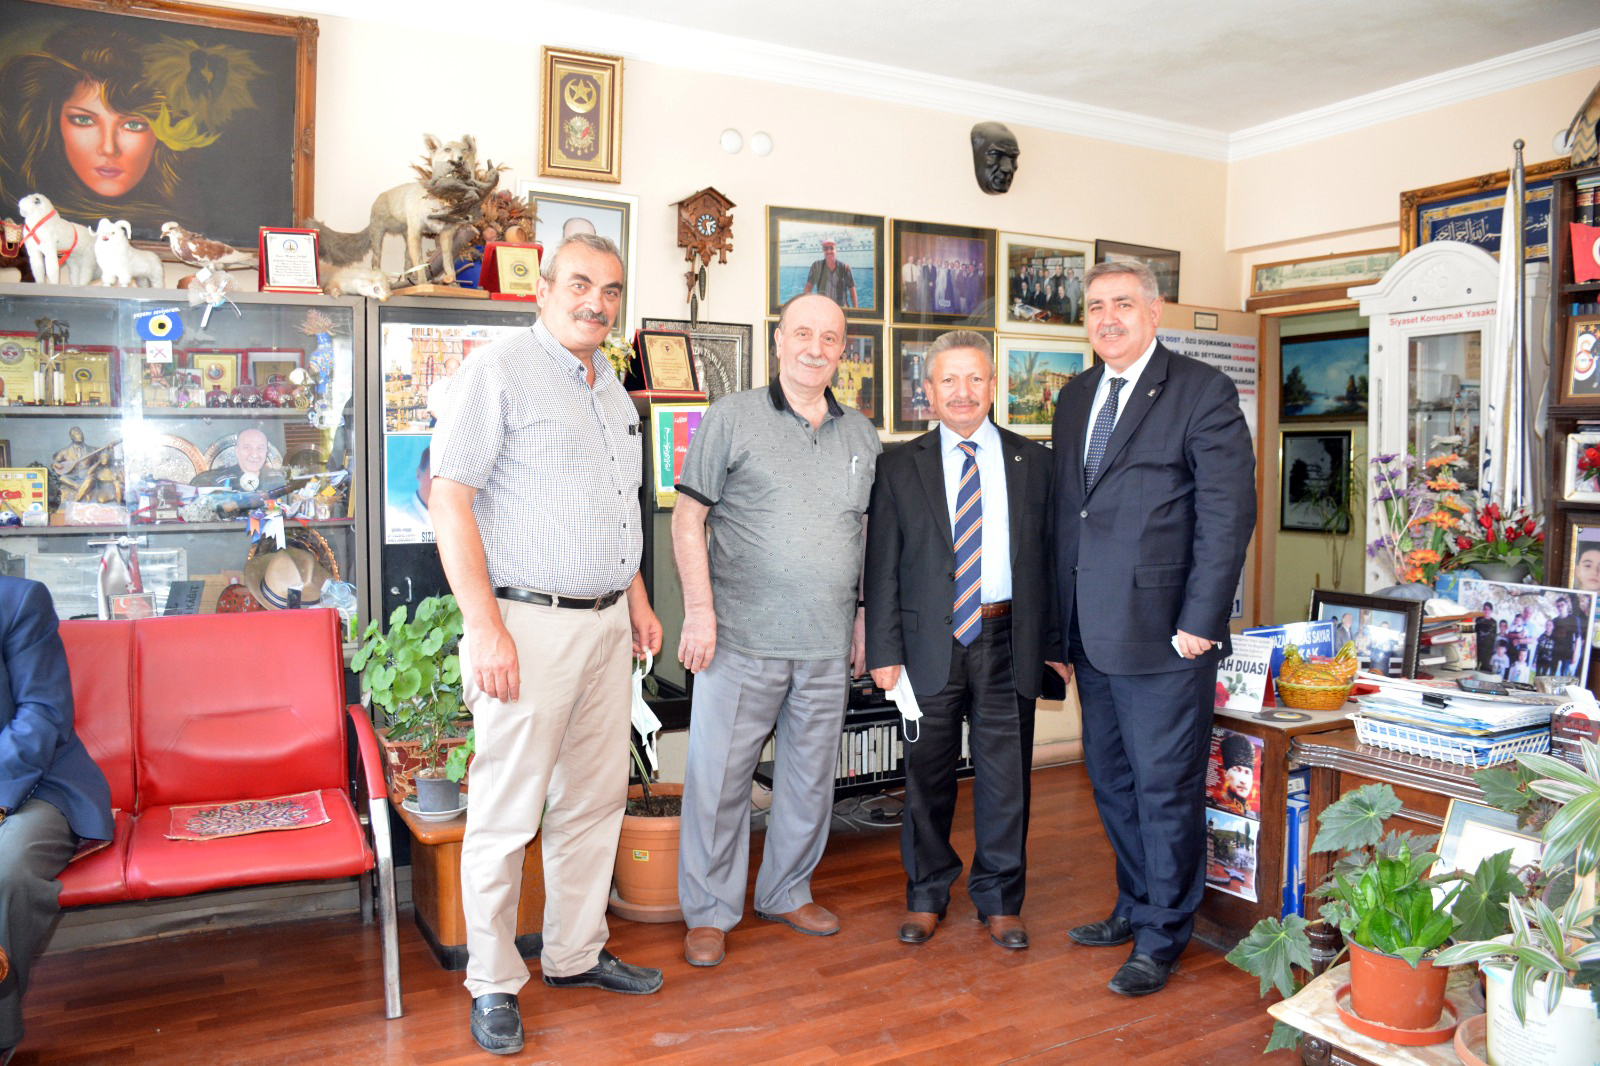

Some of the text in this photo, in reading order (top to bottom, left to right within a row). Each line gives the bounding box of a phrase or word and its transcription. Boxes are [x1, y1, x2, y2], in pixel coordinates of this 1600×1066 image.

[1389, 308, 1497, 326] Siyaset Konuşmak Yasaktı
[1165, 335, 1181, 343] DOST
[1311, 628, 1331, 644] SAYAR
[1217, 658, 1268, 676] AH DUASI
